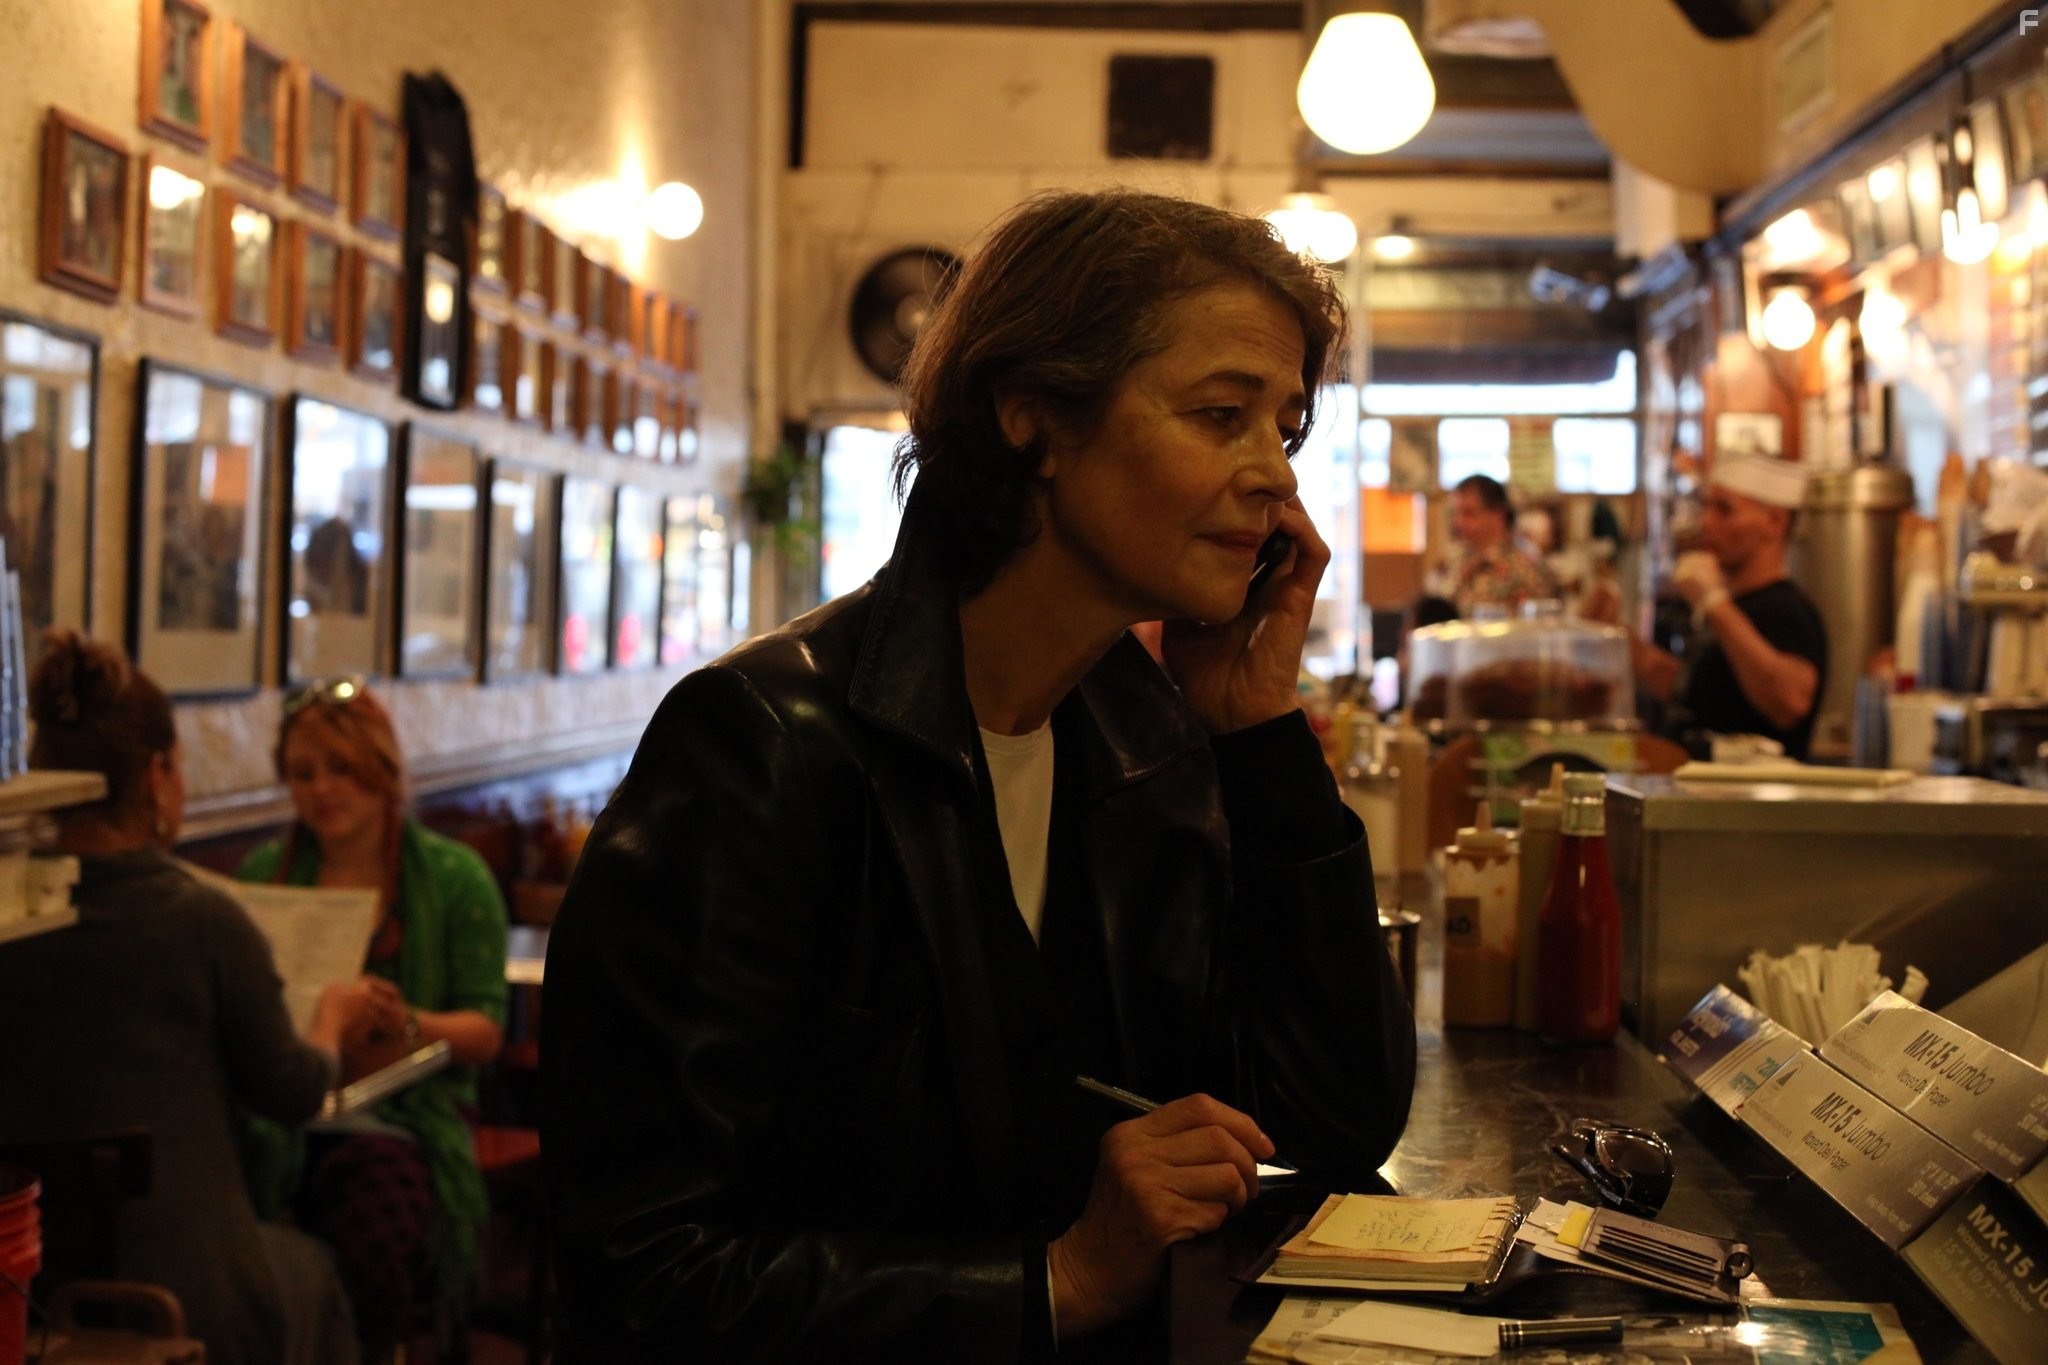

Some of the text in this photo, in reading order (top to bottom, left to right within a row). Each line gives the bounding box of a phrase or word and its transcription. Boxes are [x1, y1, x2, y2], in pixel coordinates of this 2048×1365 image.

[1902, 1029, 1960, 1070] MX-15
[1938, 1054, 1997, 1096] Jumbo
[1810, 1091, 1862, 1133] MX-15
[1840, 1118, 1899, 1162] Jumbo
[1966, 1203, 2036, 1278] MX-15
